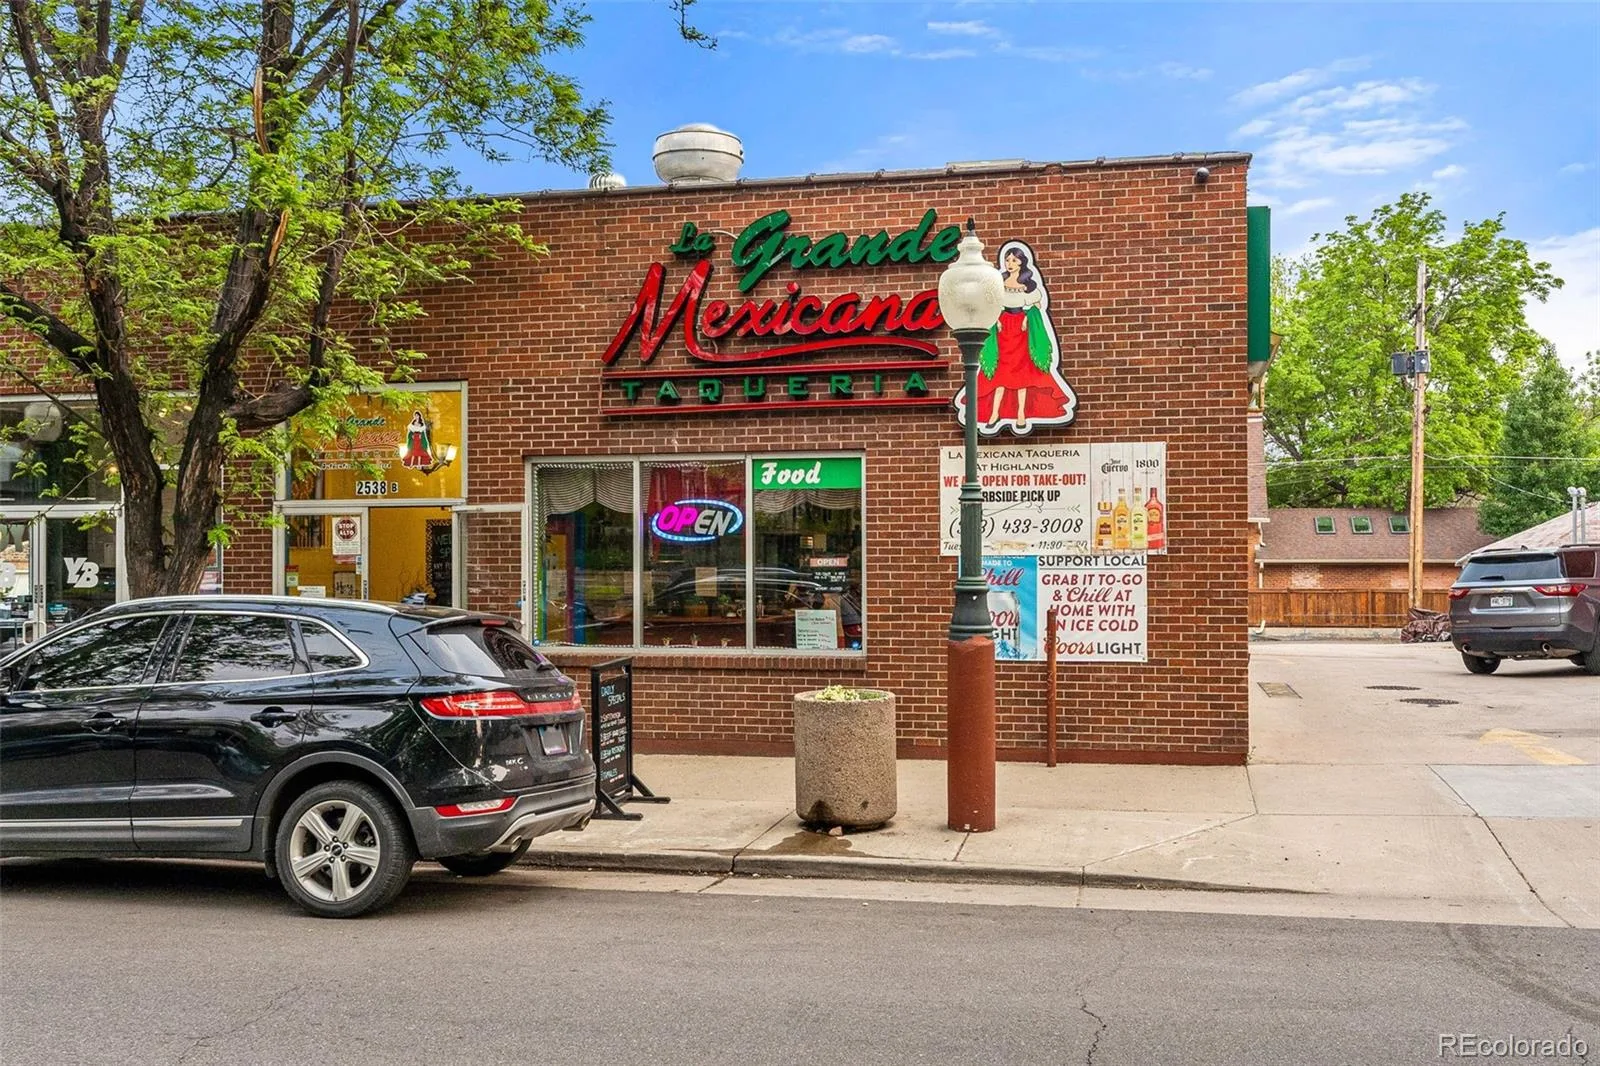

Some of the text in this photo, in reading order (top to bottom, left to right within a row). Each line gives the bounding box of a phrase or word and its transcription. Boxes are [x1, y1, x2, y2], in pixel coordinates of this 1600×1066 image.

[669, 209, 962, 293] La Grande
[601, 259, 945, 365] Mexicana
[622, 371, 929, 401] TAQUERIA
[976, 451, 1024, 459] EXICANA
[1025, 449, 1080, 458] TAQUERIA
[990, 463, 1054, 471] HIGHLANDS
[1101, 462, 1129, 474] Cuervo
[1135, 459, 1159, 468] 1800
[761, 461, 821, 485] Food
[943, 475, 959, 487] WE
[982, 475, 1008, 487] OPEN
[1011, 475, 1031, 486] FOR
[1033, 473, 1087, 486] TAKE-OUT!
[356, 481, 398, 495] 2538 B
[982, 489, 1061, 502] RBSIDE PICK UP
[656, 506, 733, 537] OPEN
[1002, 518, 1084, 534] 433-3008
[943, 541, 961, 551] Tue
[816, 558, 840, 566] OPEN
[1038, 555, 1147, 567] SUPPORT LOCAL
[1041, 574, 1143, 585] GRAB IT TO-GO
[1052, 587, 1132, 603] & Chill AT
[1050, 604, 1135, 616] HOME WITH
[1044, 619, 1139, 632] N ICE COLD
[993, 628, 1017, 640] GHT
[1097, 642, 1142, 654] LIGHT
[527, 692, 572, 700] LINCOLN
[505, 757, 524, 766] MKC
